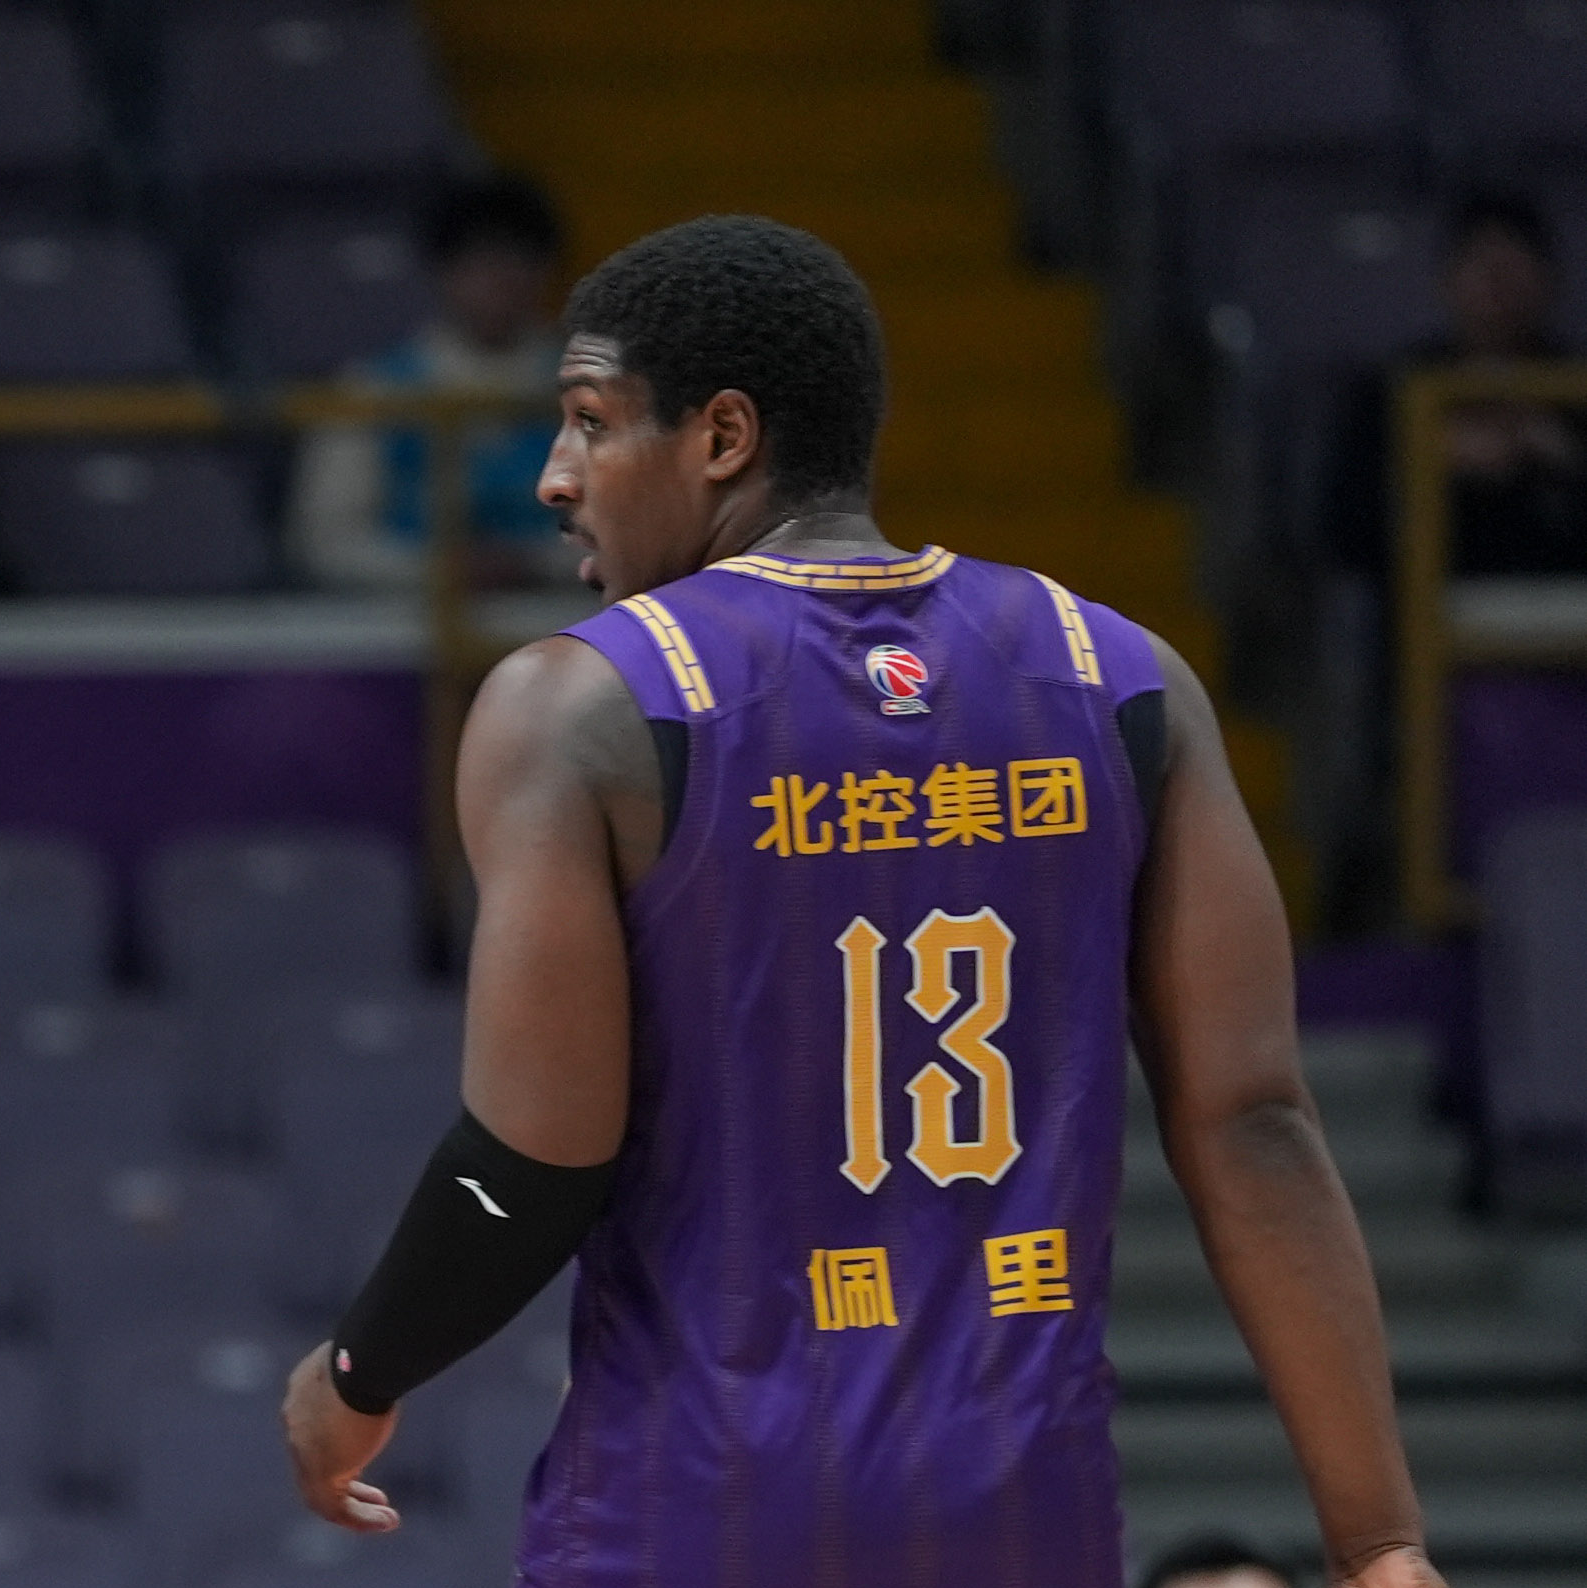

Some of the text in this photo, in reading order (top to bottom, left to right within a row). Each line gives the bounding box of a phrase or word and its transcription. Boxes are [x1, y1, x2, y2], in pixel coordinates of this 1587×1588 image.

[751, 757, 1088, 857] 北控集团
[835, 907, 1022, 1194] 13
